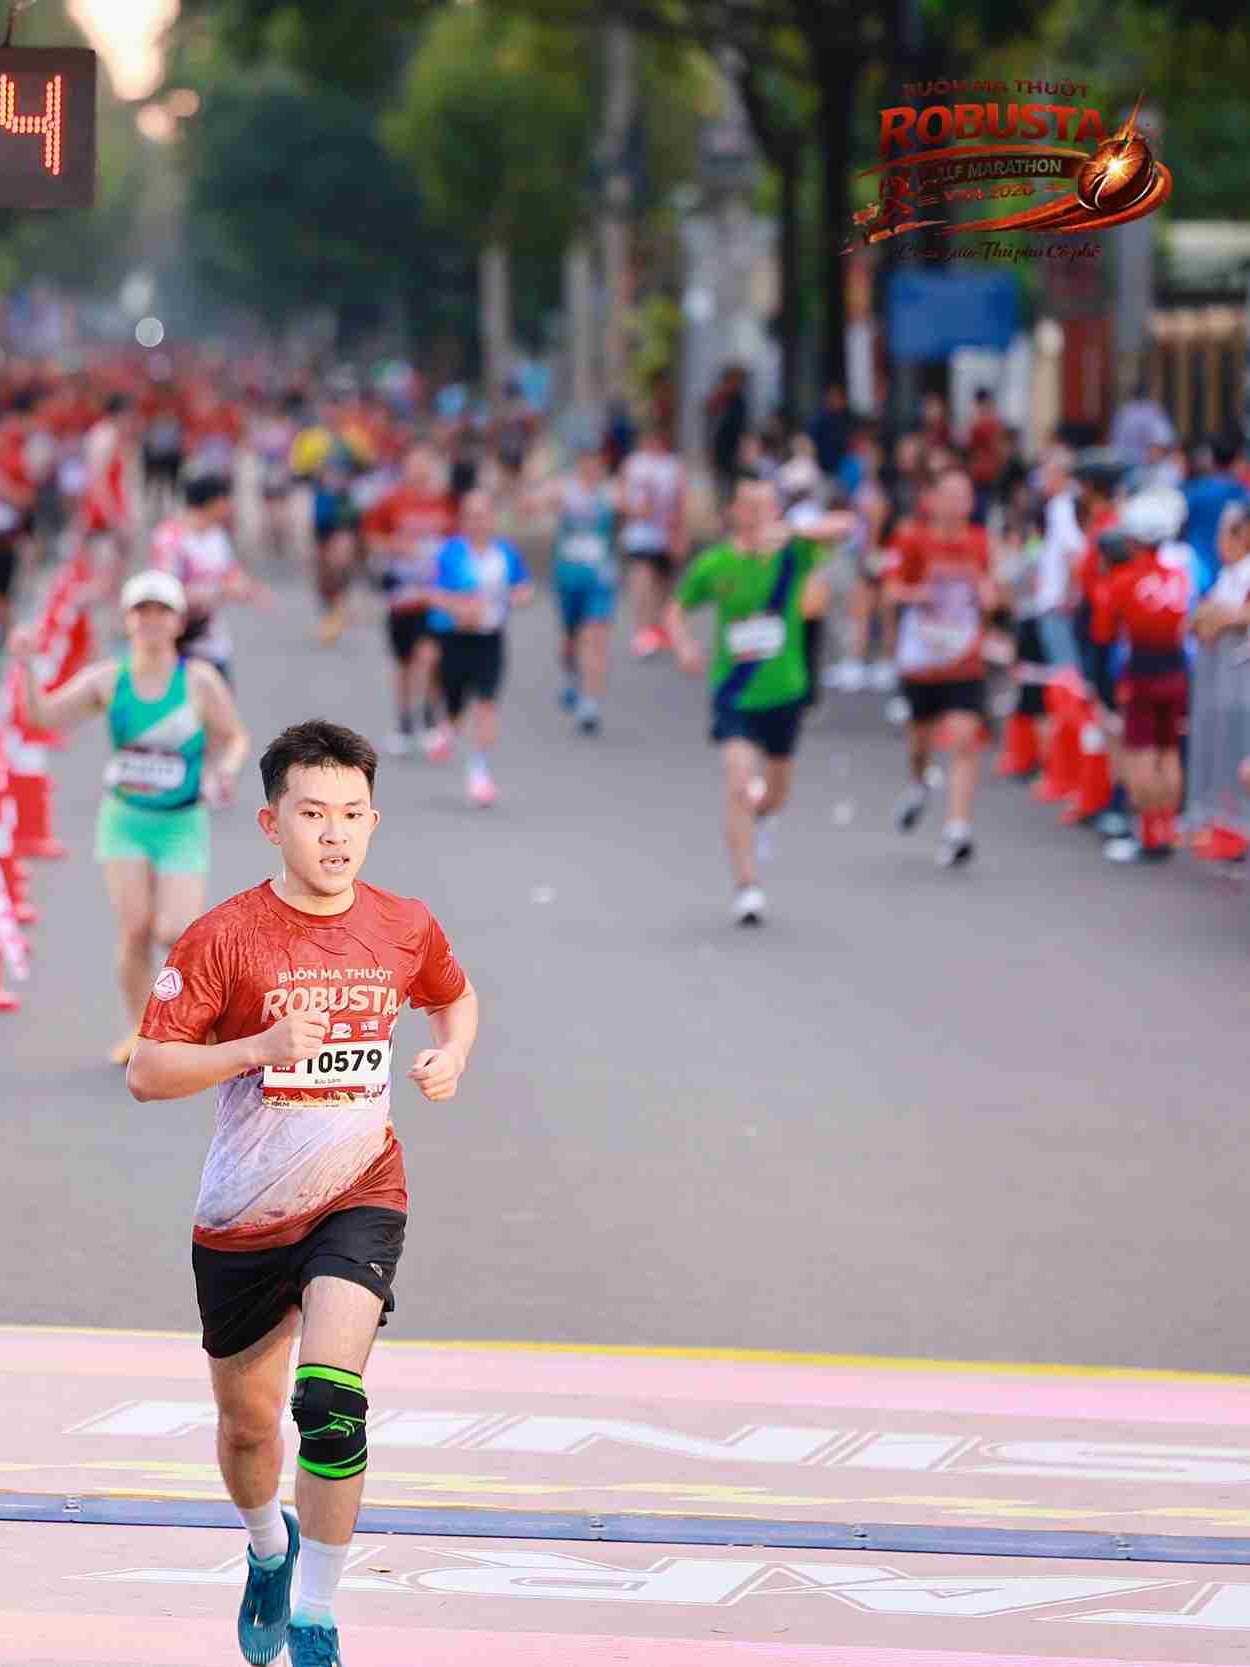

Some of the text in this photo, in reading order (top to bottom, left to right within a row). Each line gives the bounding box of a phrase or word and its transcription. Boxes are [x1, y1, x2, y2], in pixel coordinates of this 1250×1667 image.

[277, 966, 393, 984] BUÔN MA THUỘT
[261, 984, 399, 1024] ROBUSTA
[305, 1048, 383, 1074] 10579
